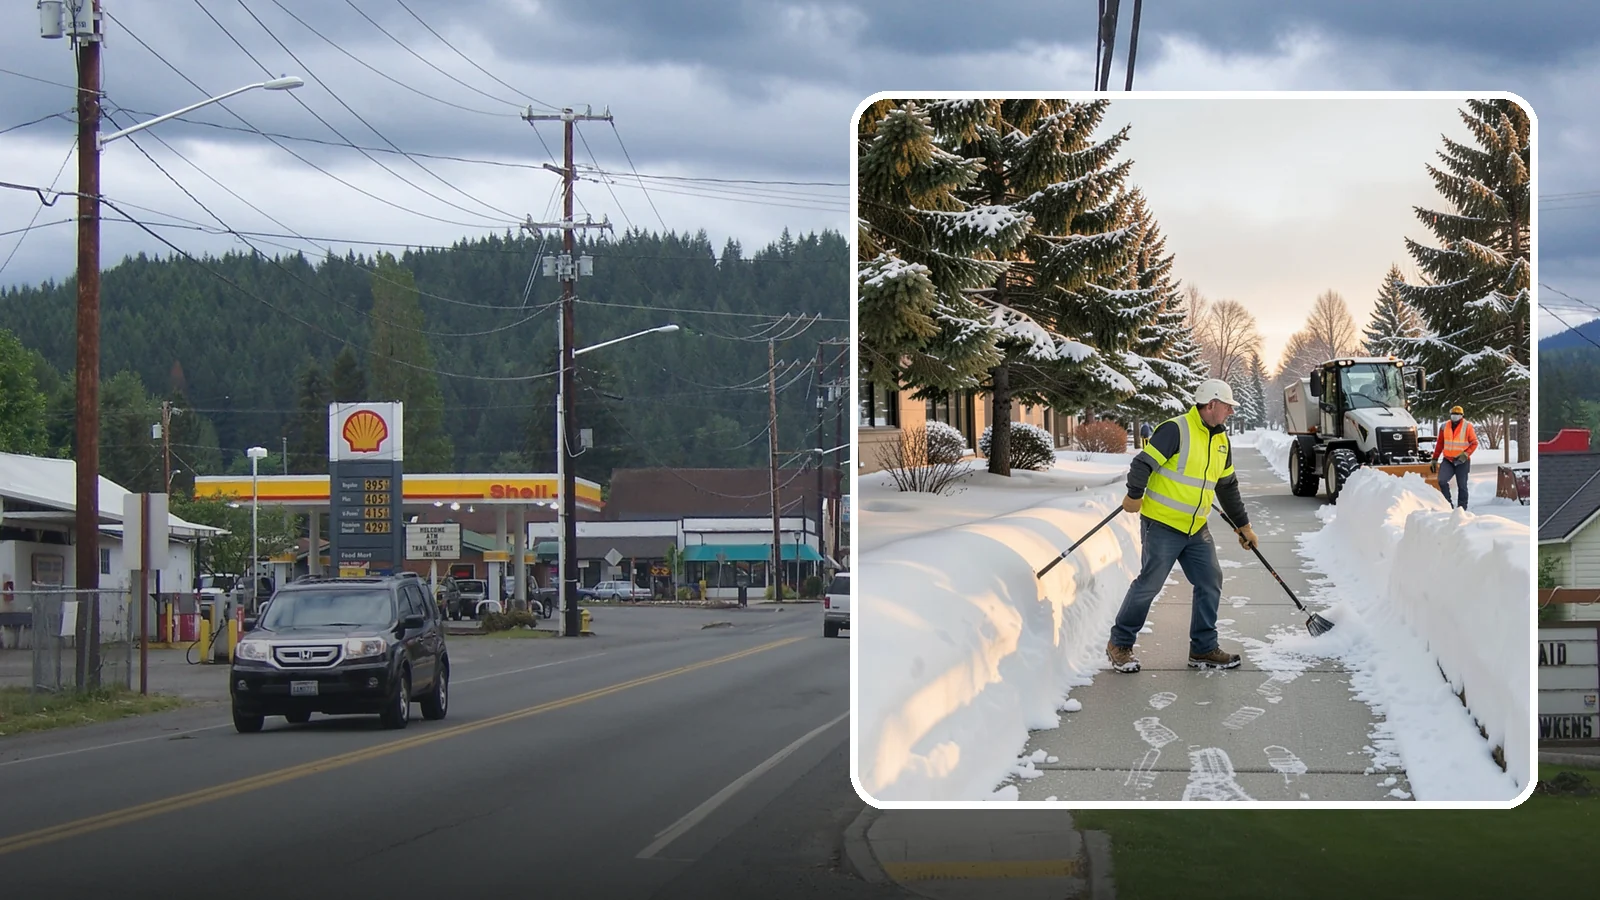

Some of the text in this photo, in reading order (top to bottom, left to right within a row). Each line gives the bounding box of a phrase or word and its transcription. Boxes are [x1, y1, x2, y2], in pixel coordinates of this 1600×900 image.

[365, 480, 384, 490] 395
[490, 484, 547, 499] Shell
[365, 494, 384, 504] 405
[365, 508, 384, 518] 415
[365, 522, 384, 533] 429
